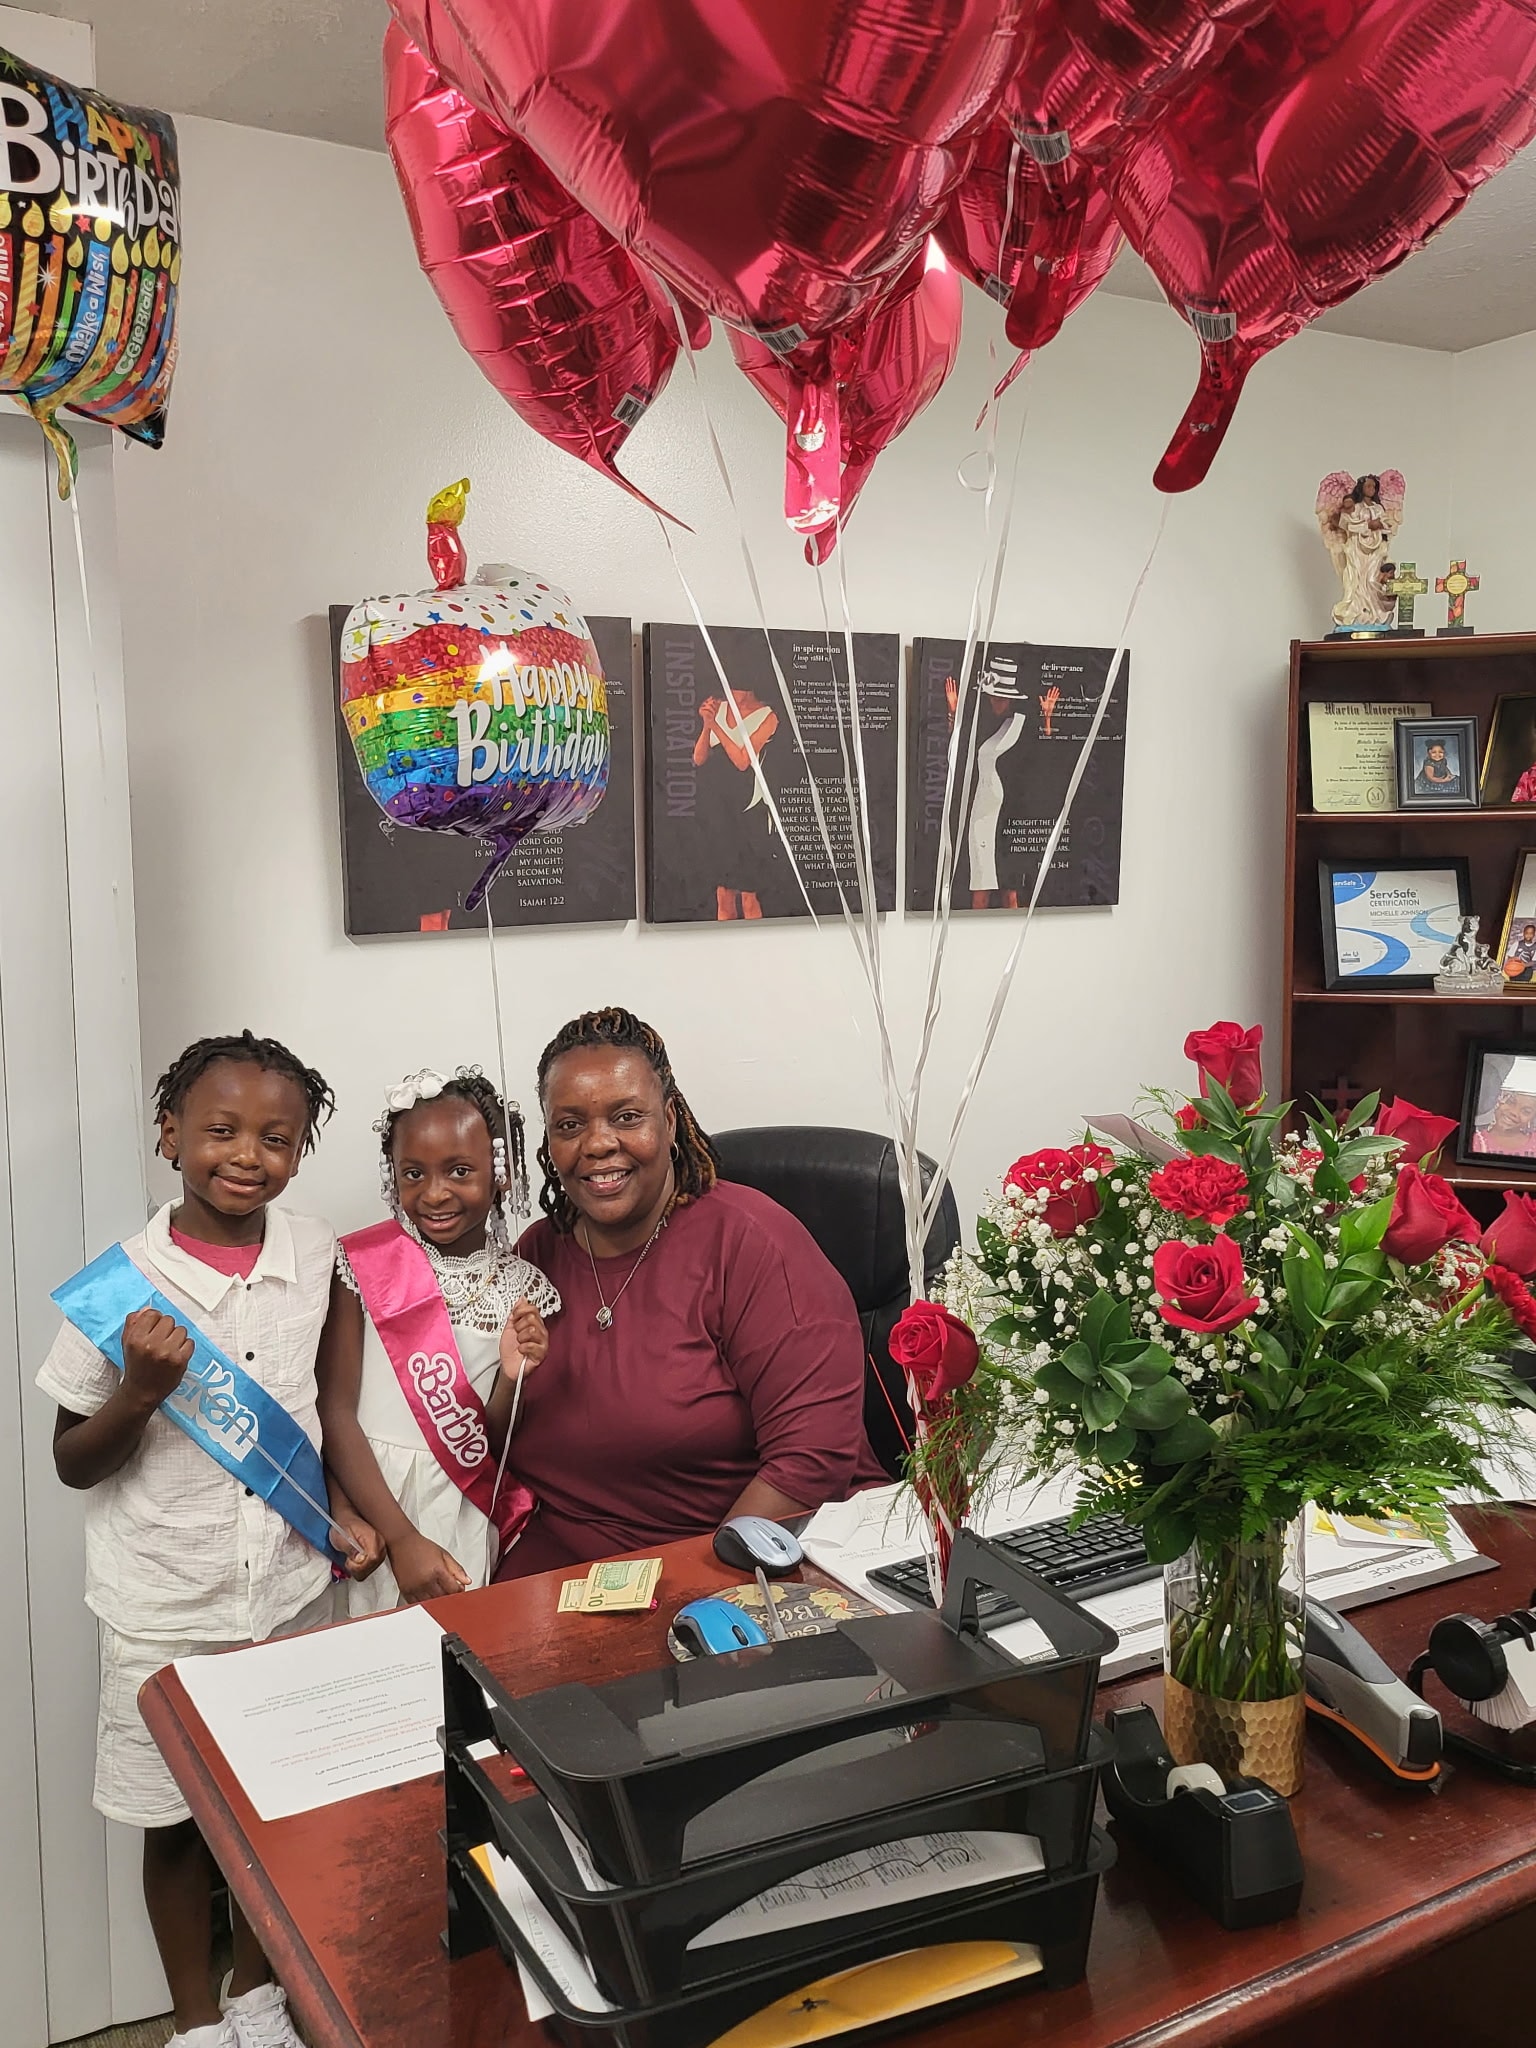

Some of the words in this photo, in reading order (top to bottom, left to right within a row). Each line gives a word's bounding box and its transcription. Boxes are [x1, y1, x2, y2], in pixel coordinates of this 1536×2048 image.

[477, 641, 593, 728] Happy
[1324, 702, 1360, 716] Martin
[1362, 702, 1417, 717] University
[665, 640, 697, 817] INSPIRATION
[447, 699, 608, 791] Birthday
[782, 806, 803, 814] WHAT
[1012, 818, 1037, 826] SOUGHT
[1039, 818, 1051, 826] THE
[543, 836, 563, 844] GOD
[545, 847, 564, 855] AND
[800, 843, 813, 851] ARE
[1010, 845, 1028, 853] FROM
[795, 853, 824, 861] TEACHES
[517, 868, 549, 876] BECOME
[552, 867, 564, 875] MY
[518, 877, 565, 886] SALVATION.
[845, 879, 858, 887] 3:16
[1370, 888, 1417, 899] ServSafe
[520, 898, 546, 907] ISAIAH
[550, 896, 565, 905] 12:2
[1370, 899, 1420, 907] CERTIFICATION
[198, 1361, 258, 1449] Ken
[410, 1354, 487, 1466] Barbie
[588, 1593, 604, 1608] 10
